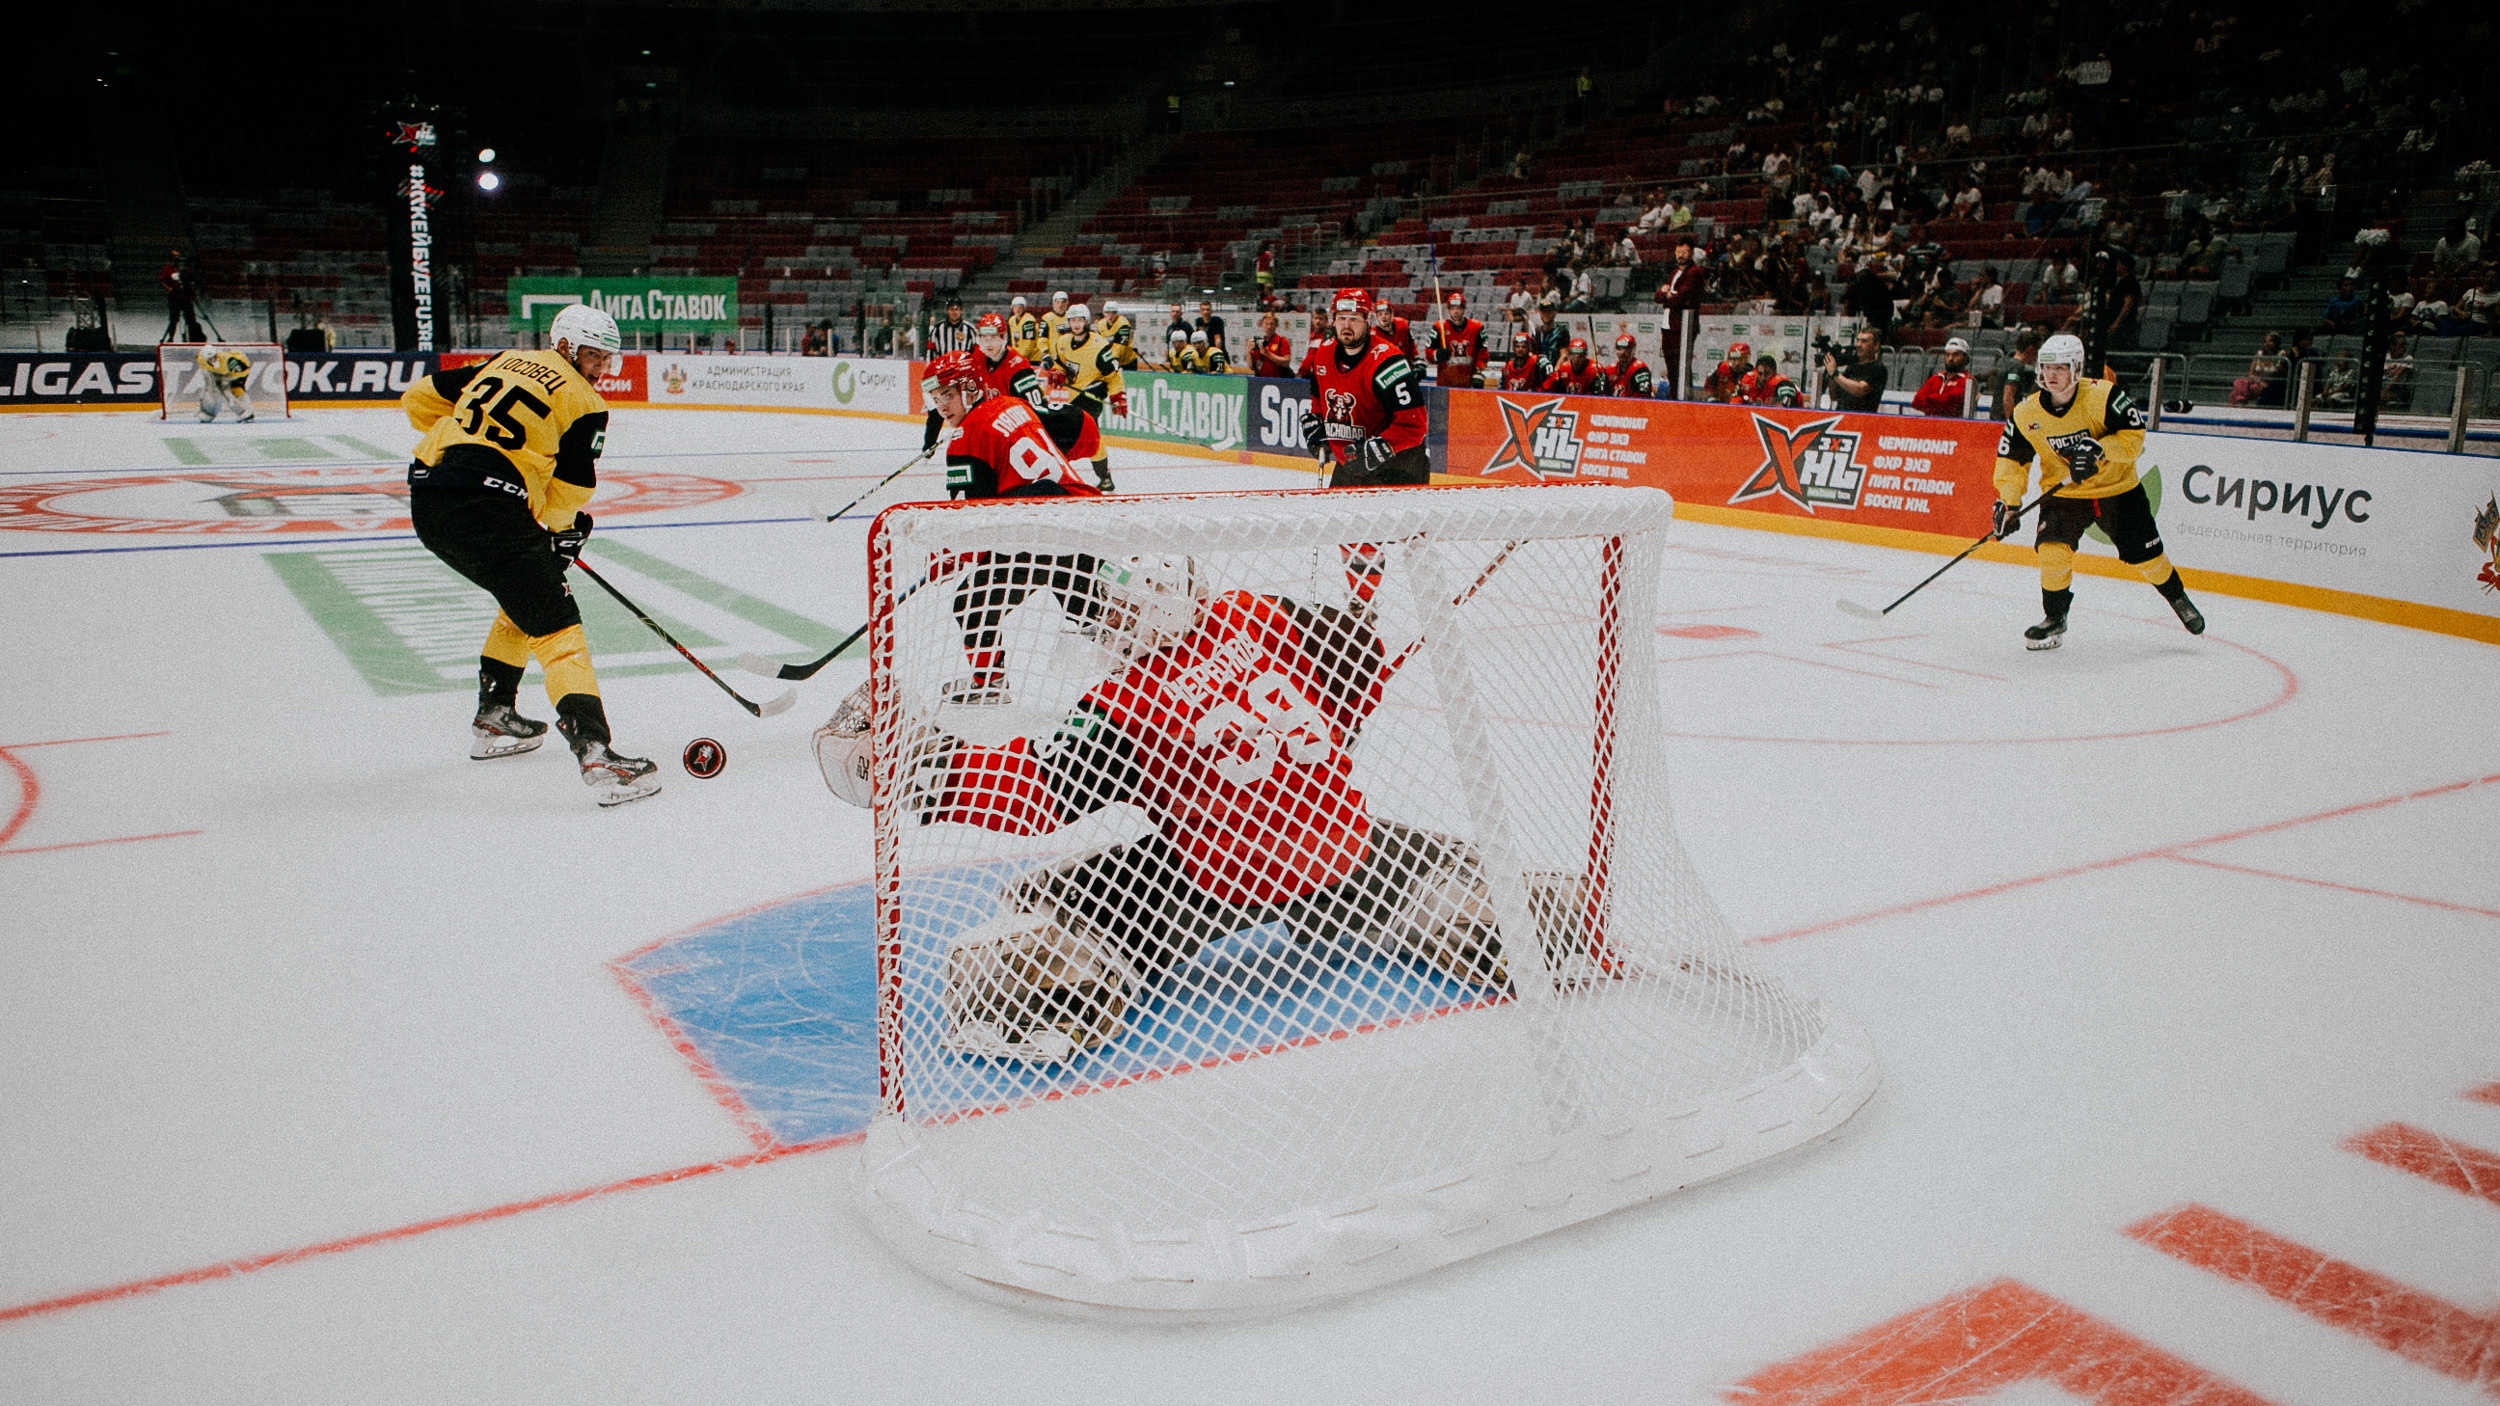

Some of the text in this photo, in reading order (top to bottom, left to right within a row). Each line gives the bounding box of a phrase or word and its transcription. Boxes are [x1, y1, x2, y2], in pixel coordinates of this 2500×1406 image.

[648, 289, 727, 320] СТАВОК
[707, 366, 792, 377] АДМИНИСТРАЦИЯ
[859, 370, 896, 391] Сириус
[594, 378, 632, 392] ССИИ
[692, 380, 805, 393] КРАСНОДАРСКОГО КРАЯ
[1395, 382, 1411, 405] 5
[1025, 388, 1042, 408] 10
[455, 376, 552, 450] 35
[1152, 378, 1244, 443] СТАВОК
[1590, 414, 1648, 430] ЧЕМПИОНАТ
[1878, 435, 1958, 455] ЧЕМПИОНАТ
[1584, 447, 1647, 464] ЛИГА СТАВОК
[1873, 455, 1902, 471] ФХР
[1580, 463, 1610, 477] SOCHI
[483, 476, 529, 499] CCM
[1867, 474, 1955, 496] ЛИГА СТАВОК
[1863, 493, 1902, 510] SOCHI
[1904, 496, 1930, 513] XHL
[2182, 465, 2373, 529] Сириус
[2176, 521, 2273, 545] федеральная
[2279, 535, 2367, 558] территория
[1196, 670, 1331, 785] 39
